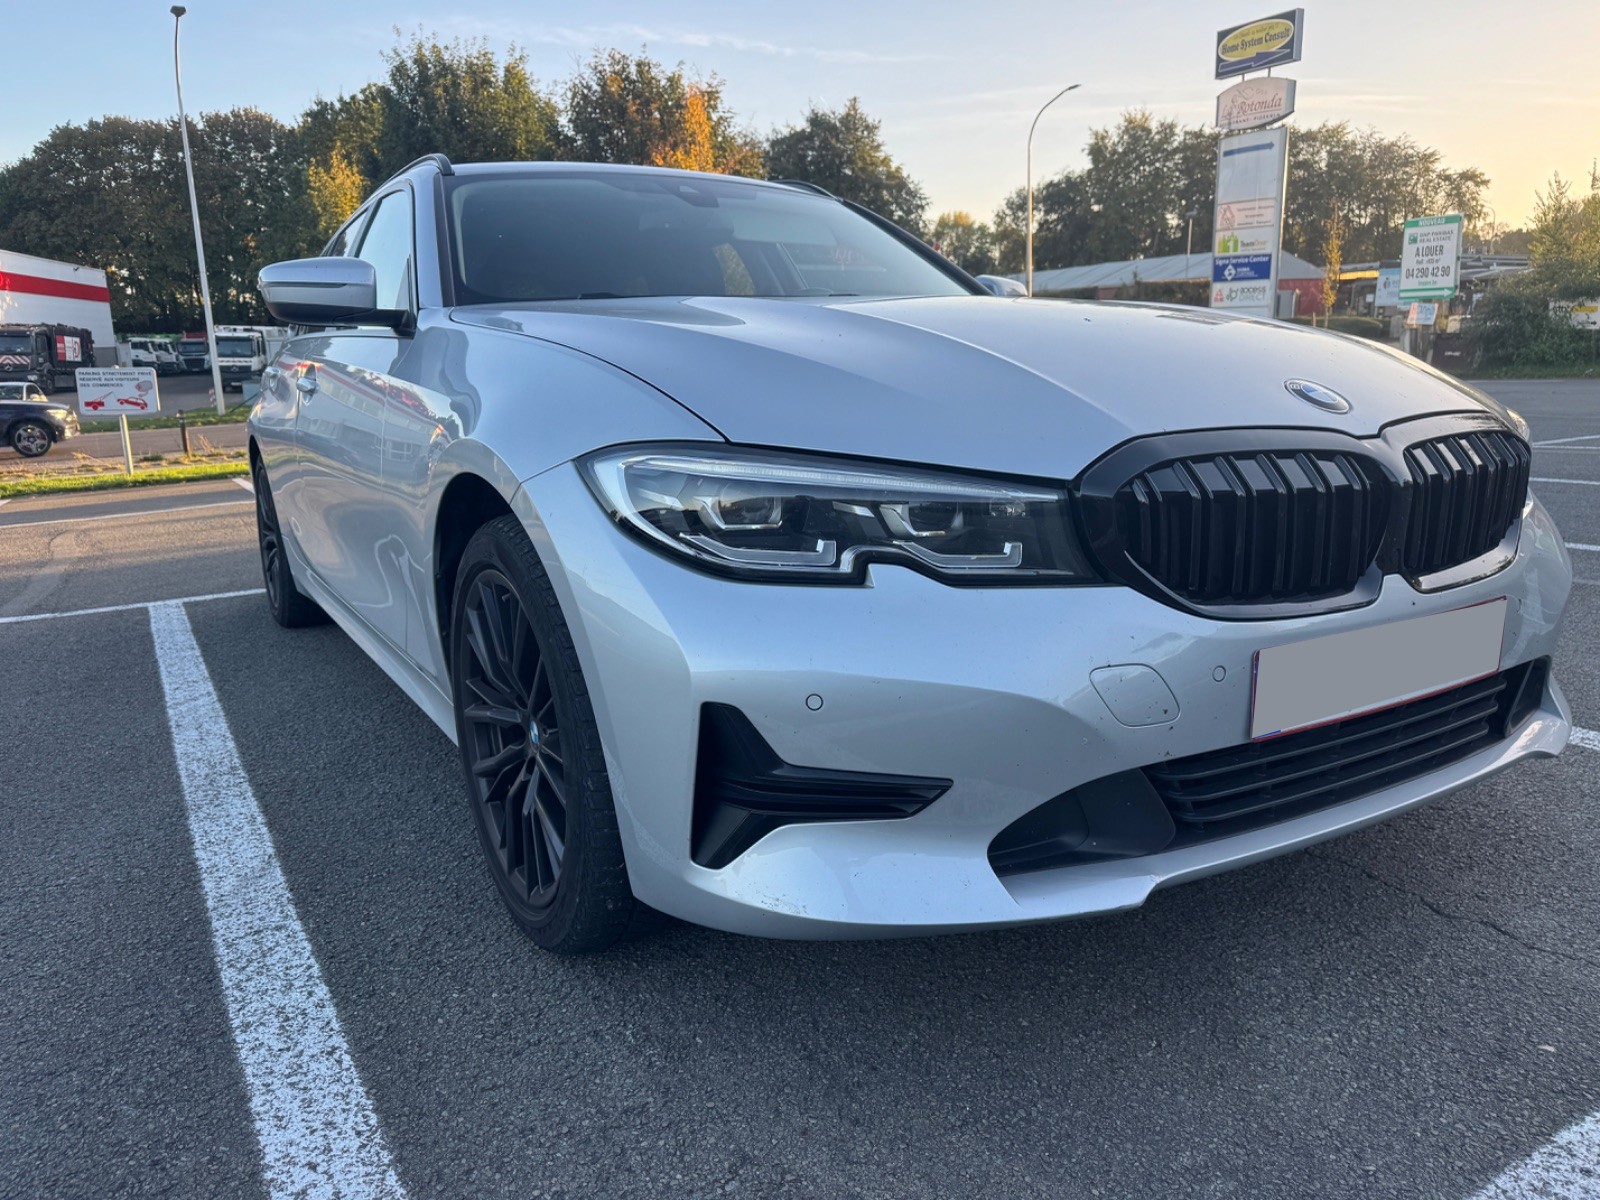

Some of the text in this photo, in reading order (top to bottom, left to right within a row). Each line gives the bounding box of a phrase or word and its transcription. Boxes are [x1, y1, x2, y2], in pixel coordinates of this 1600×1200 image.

[1240, 36, 1263, 51] System
[1264, 27, 1290, 43] Consult
[1238, 93, 1282, 115] Rotonda
[1418, 217, 1445, 227] NOUVEAU
[1415, 245, 1444, 258] A LOUER
[1405, 265, 1450, 279] 04 290 42 90
